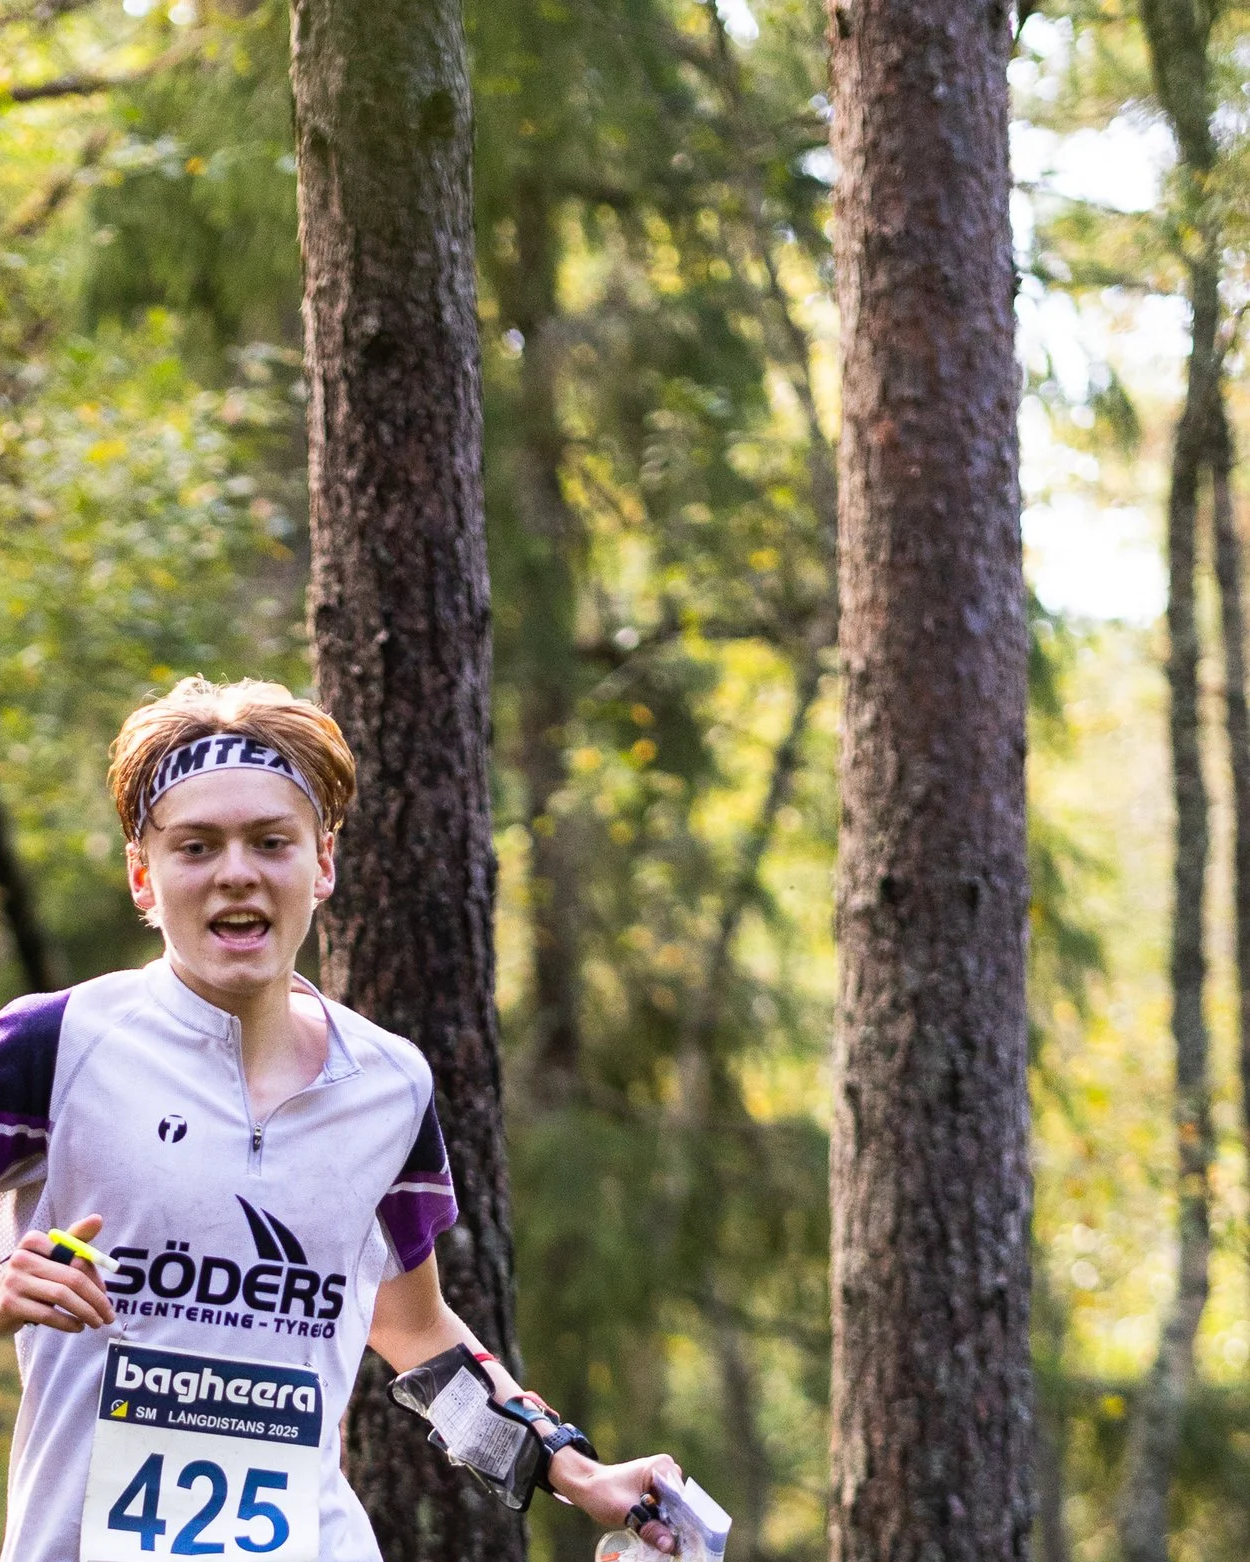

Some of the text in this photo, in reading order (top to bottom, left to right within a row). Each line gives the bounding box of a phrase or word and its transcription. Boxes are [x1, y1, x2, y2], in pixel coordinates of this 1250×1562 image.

[150, 737, 294, 797] IMTEX
[104, 1239, 347, 1320] SÖDERS
[107, 1296, 254, 1328] RIENTERING
[115, 1355, 316, 1413] bagheera
[135, 1406, 157, 1420] SM
[267, 1423, 299, 1438] 2025
[107, 1452, 290, 1555] 425
